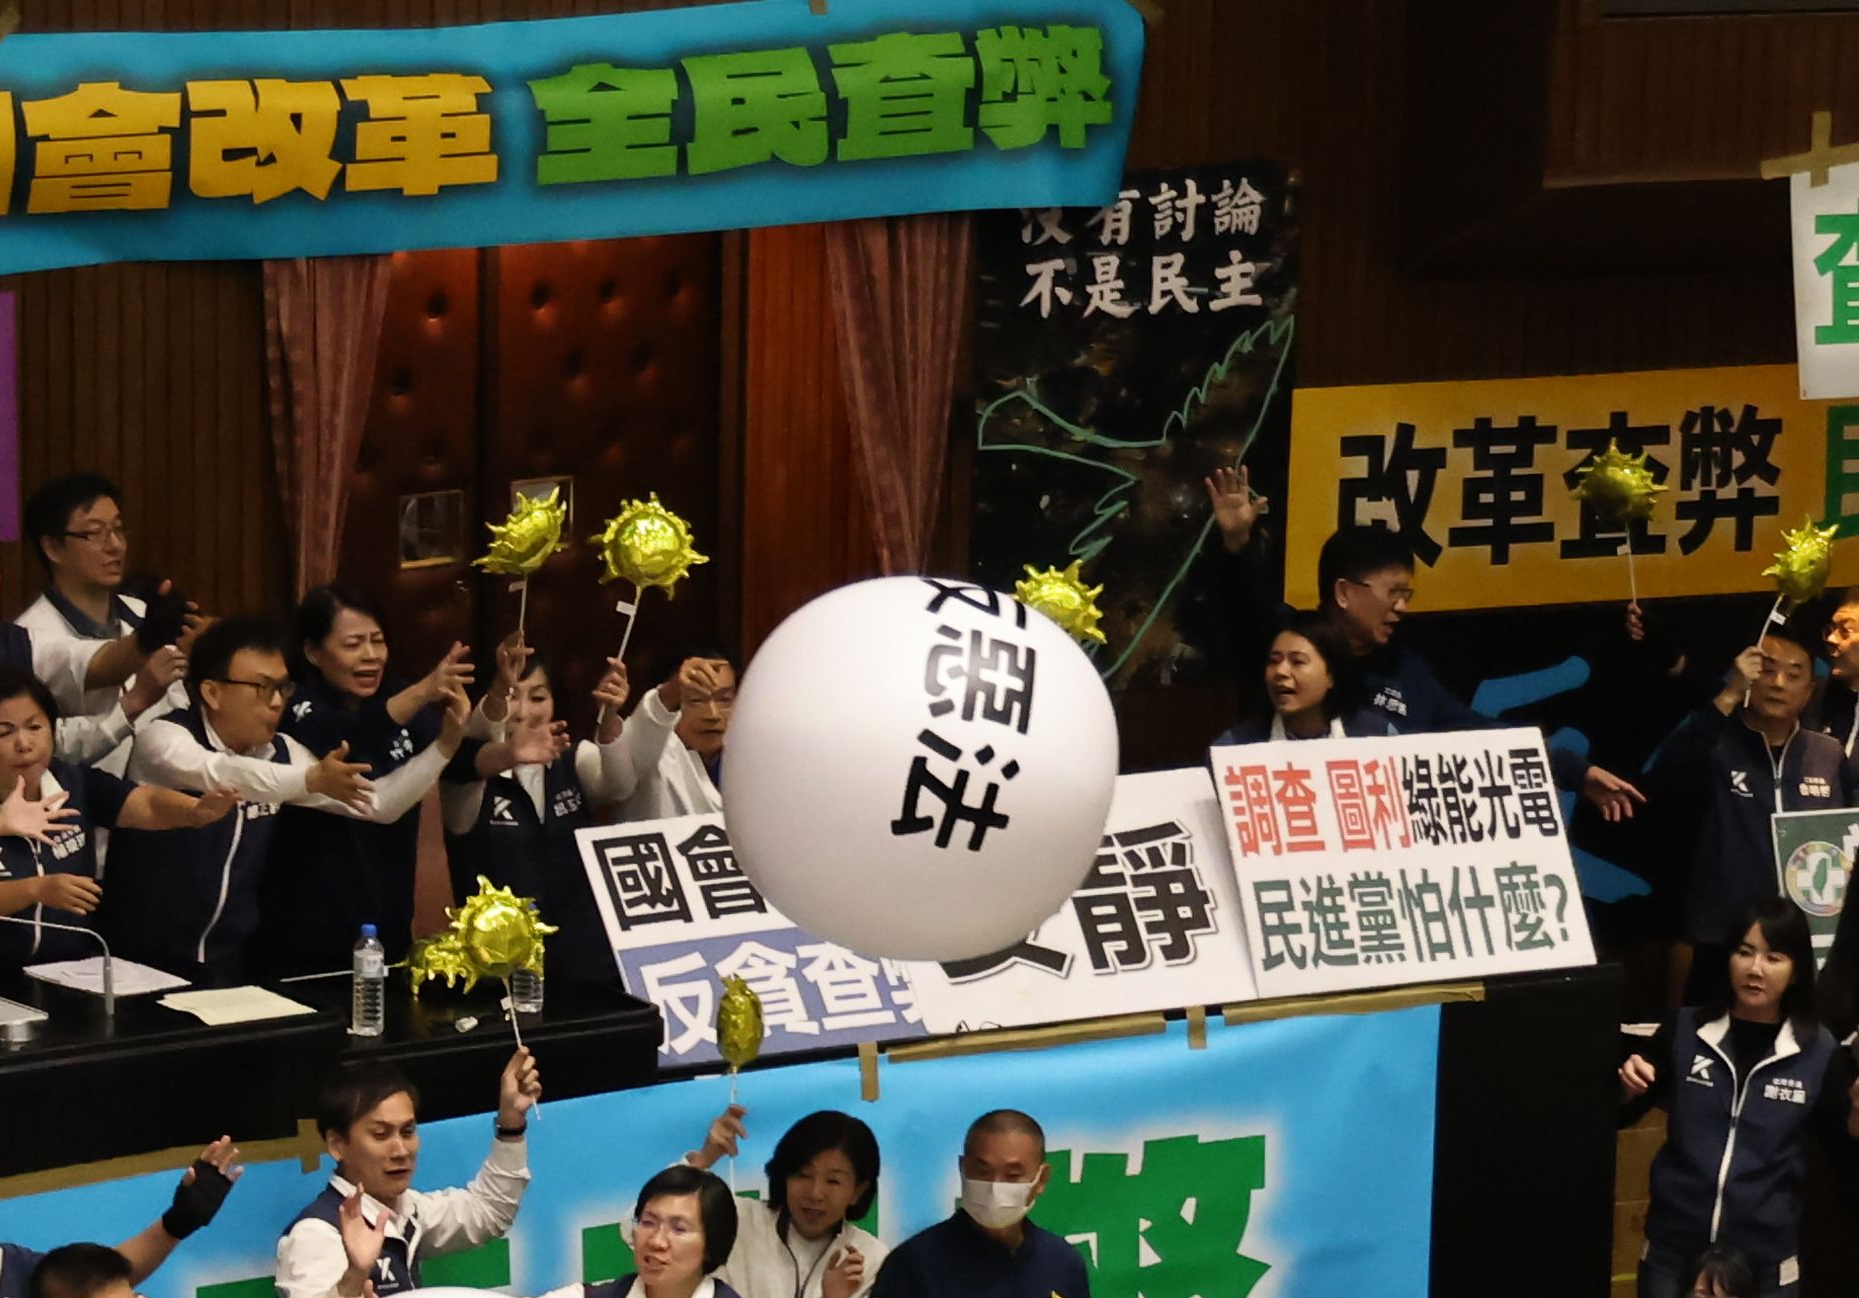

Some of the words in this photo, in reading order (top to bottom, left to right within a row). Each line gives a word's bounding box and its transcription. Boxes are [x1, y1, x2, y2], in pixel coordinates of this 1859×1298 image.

[527, 25, 1113, 186] 全民查弊
[1020, 250, 1264, 318] 不是民主
[1340, 404, 1783, 569] 改革查弊
[1224, 762, 1327, 858] 調查
[1324, 748, 1559, 853] 圖利綠能光電
[1252, 861, 1570, 972] 民進黨怕什麼?
[639, 940, 918, 1056] 反貪查
